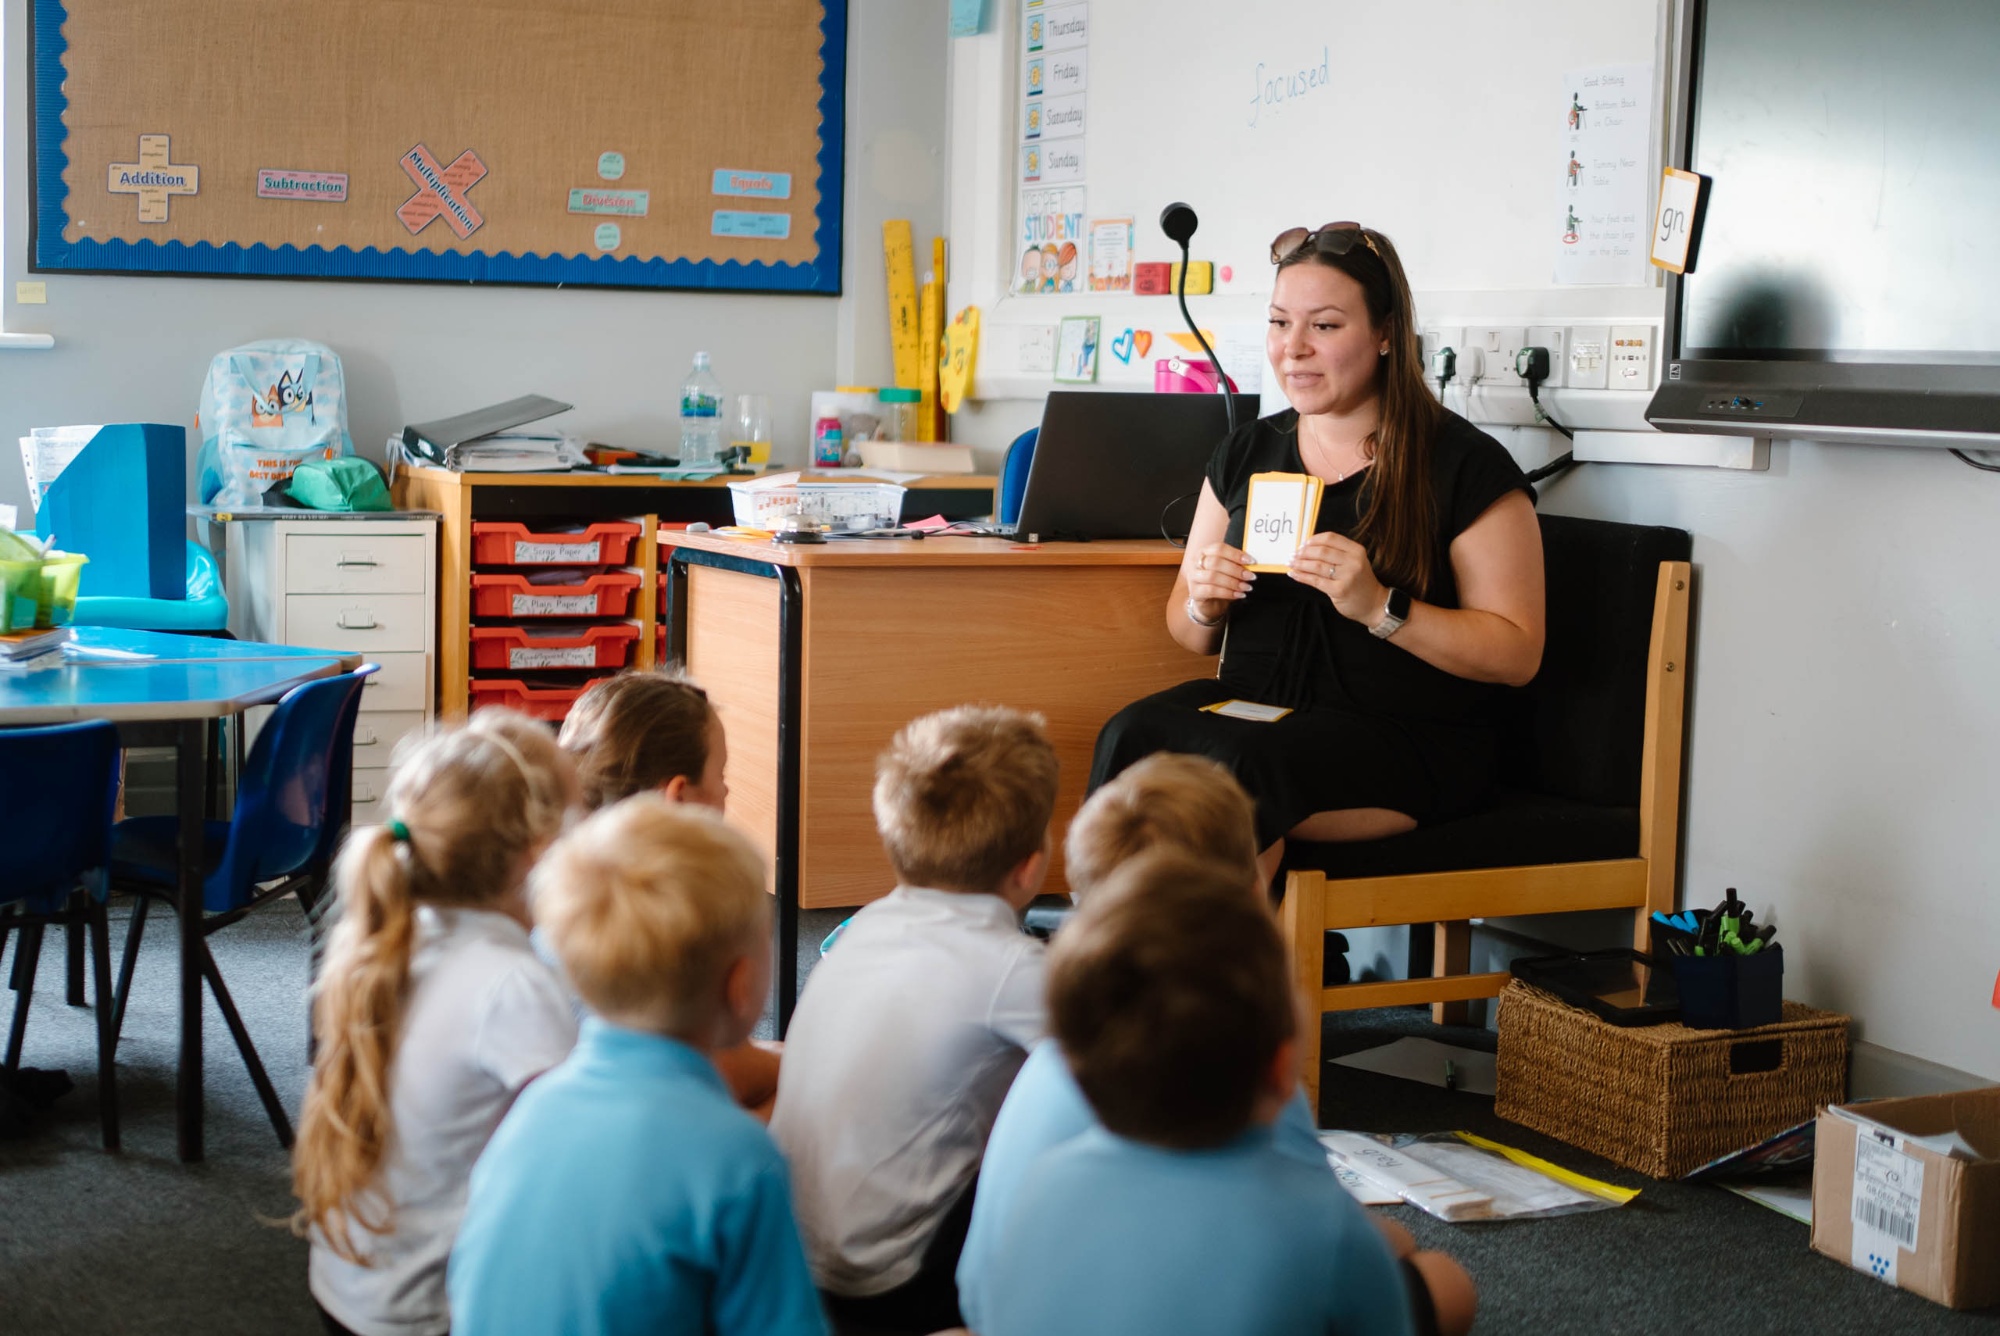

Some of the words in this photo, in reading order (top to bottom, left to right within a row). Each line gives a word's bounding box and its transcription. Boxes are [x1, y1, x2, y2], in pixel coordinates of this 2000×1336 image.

[1048, 17, 1085, 38] Thursday
[1053, 63, 1079, 83] Friday
[1248, 45, 1329, 127] focused
[1046, 107, 1082, 128] Saturday
[1048, 150, 1079, 173] Sunday
[119, 171, 186, 187] Addition
[264, 176, 343, 193] Subtraction
[409, 151, 474, 231] Multiplication
[581, 192, 635, 208] Division
[1023, 213, 1083, 241] STUDENT
[1660, 207, 1684, 241] gn
[257, 459, 278, 468] THIS
[1254, 511, 1294, 542] eigh
[533, 546, 556, 556] Scrap
[559, 546, 582, 556] Paper
[531, 599, 552, 608] Plain
[556, 599, 578, 609] Paper
